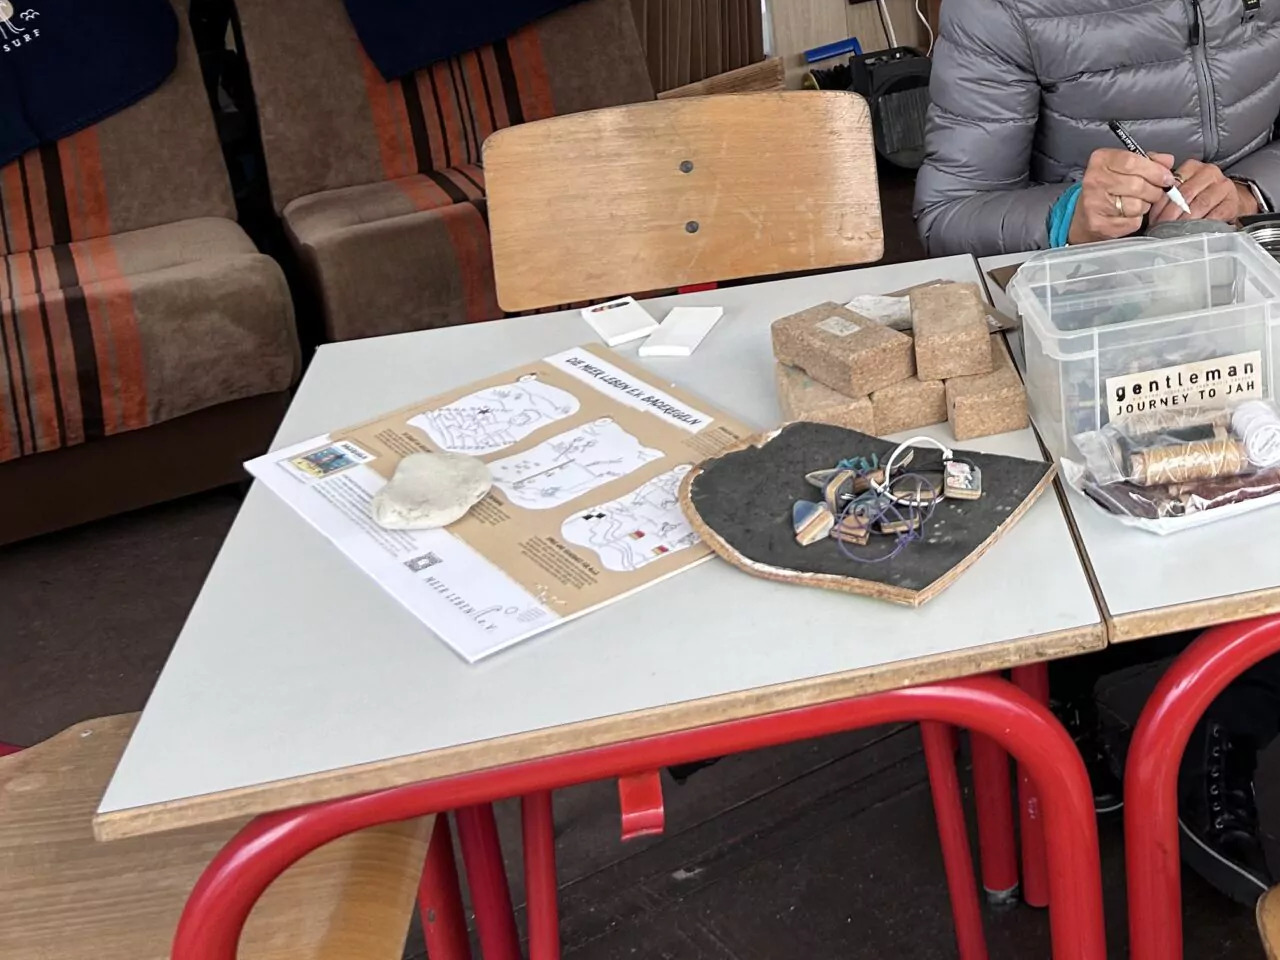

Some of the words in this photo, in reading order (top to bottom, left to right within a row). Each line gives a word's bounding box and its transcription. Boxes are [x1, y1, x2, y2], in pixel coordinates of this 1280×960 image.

[3, 28, 40, 52] SURF
[566, 357, 584, 368] DIE
[577, 363, 605, 379] MEER
[600, 374, 631, 391] LEBEN
[641, 395, 702, 426] BADEREGELN
[1115, 362, 1255, 402] gentleman
[1117, 393, 1190, 416] JOURNEY
[1199, 388, 1217, 401] TO
[1226, 380, 1255, 395] JAH
